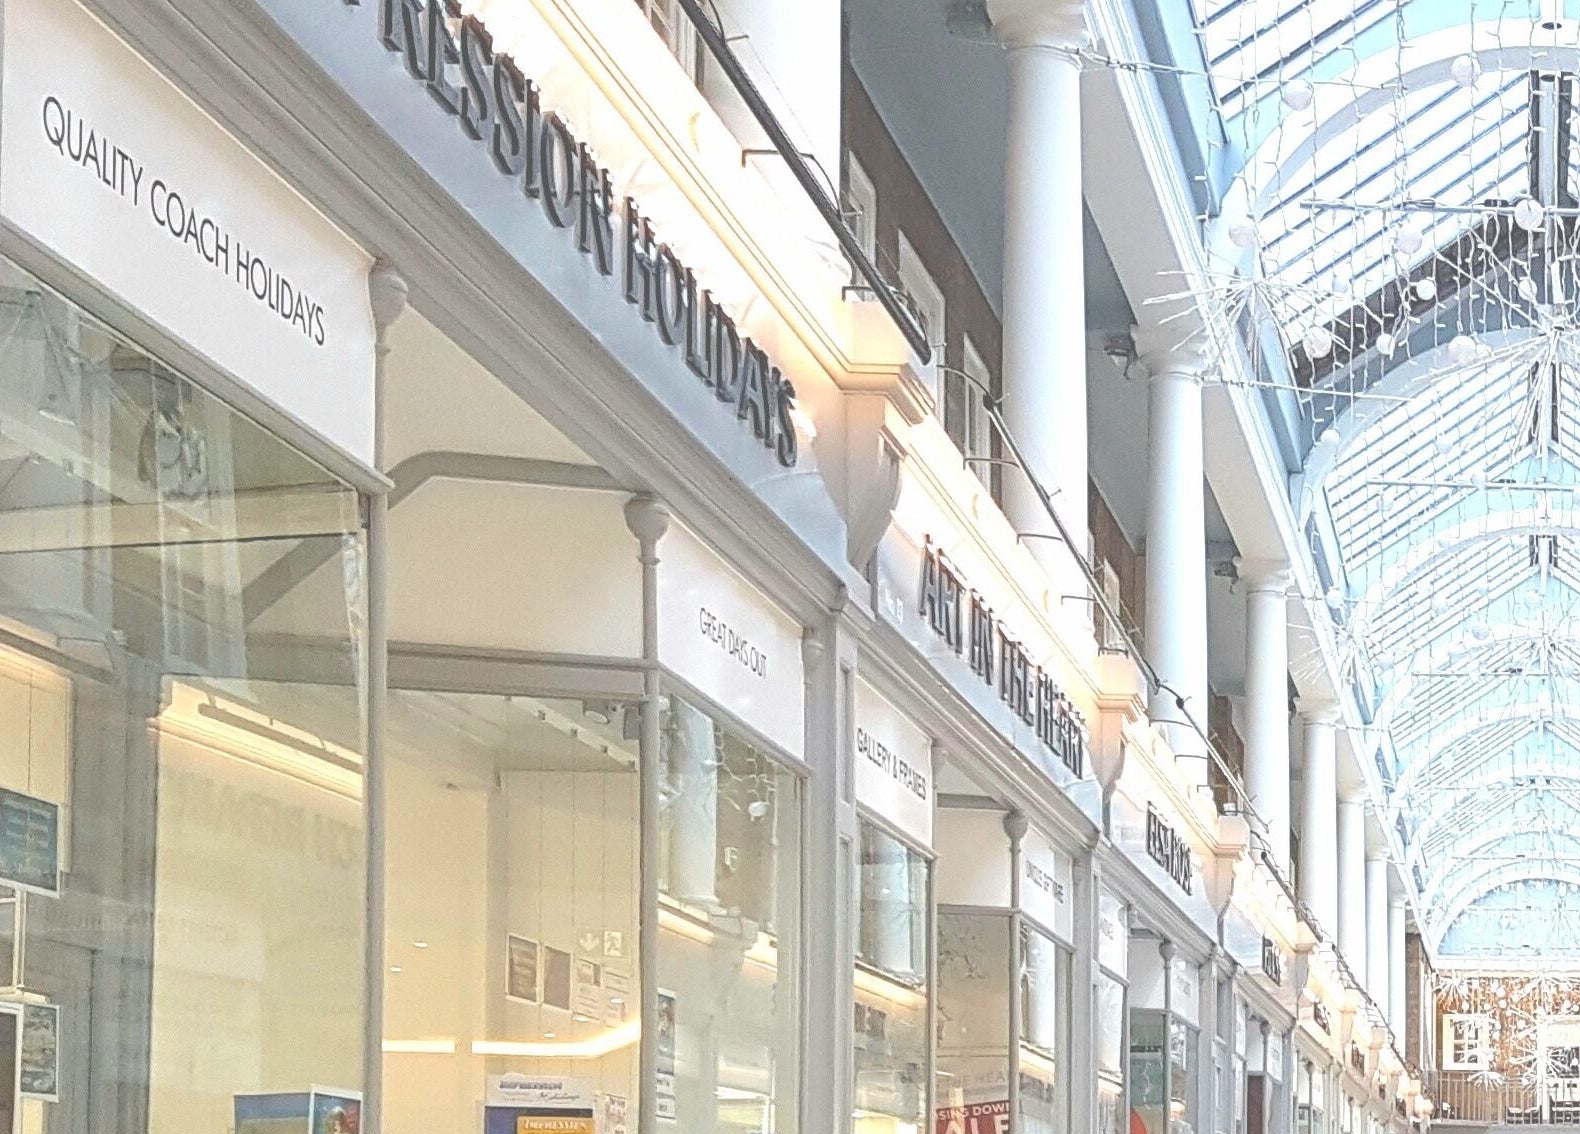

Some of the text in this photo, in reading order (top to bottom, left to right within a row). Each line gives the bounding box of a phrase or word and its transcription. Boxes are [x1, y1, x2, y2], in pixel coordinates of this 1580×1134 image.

[41, 95, 326, 347] QUALITY COACH HOLIDAYS
[622, 196, 797, 467] HOLIDAYS
[699, 607, 768, 680] GREAT DAYS OUT
[918, 534, 963, 654] ART
[969, 588, 993, 686] IN
[857, 727, 892, 775] GALLERY
[899, 761, 927, 801] FRAMES
